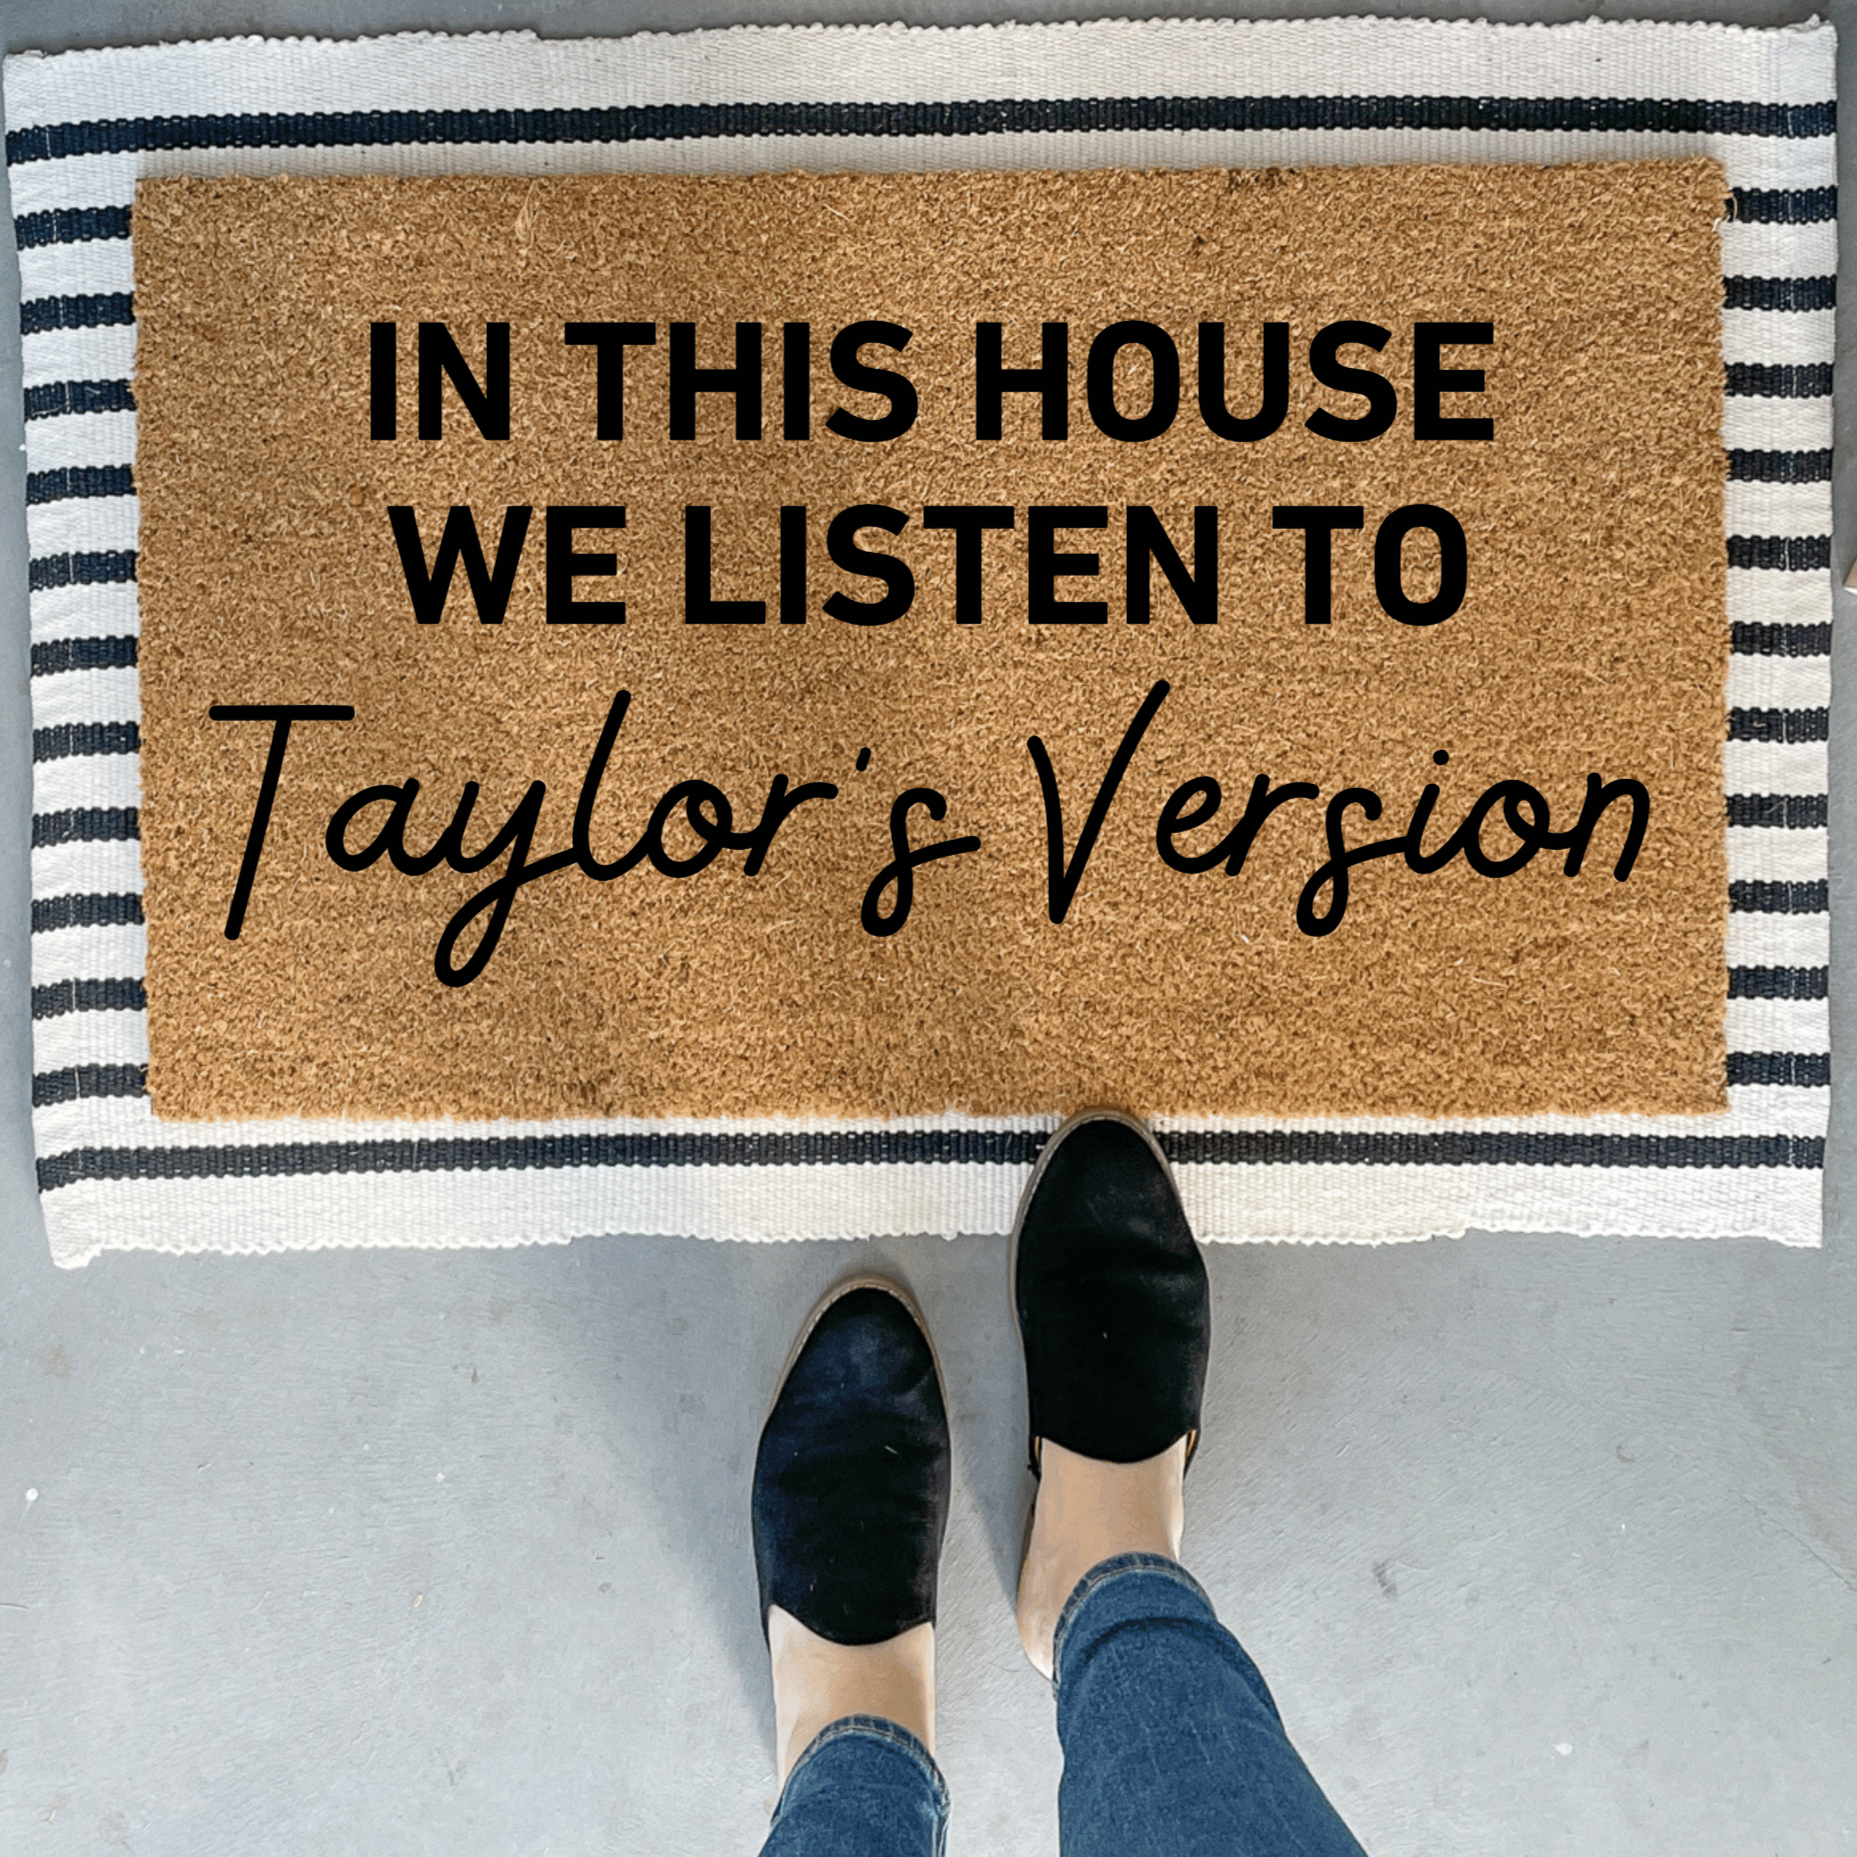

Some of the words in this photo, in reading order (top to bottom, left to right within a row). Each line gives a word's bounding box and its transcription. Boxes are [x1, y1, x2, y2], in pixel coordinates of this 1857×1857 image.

[370, 321, 511, 441] IN
[564, 320, 919, 443] THIS
[975, 319, 1494, 443] HOUSE
[386, 505, 627, 625] WE
[684, 503, 1219, 627] LISTEN
[1272, 503, 1468, 627] TO
[208, 689, 982, 988] Taylor's
[1026, 679, 1651, 938] Version
